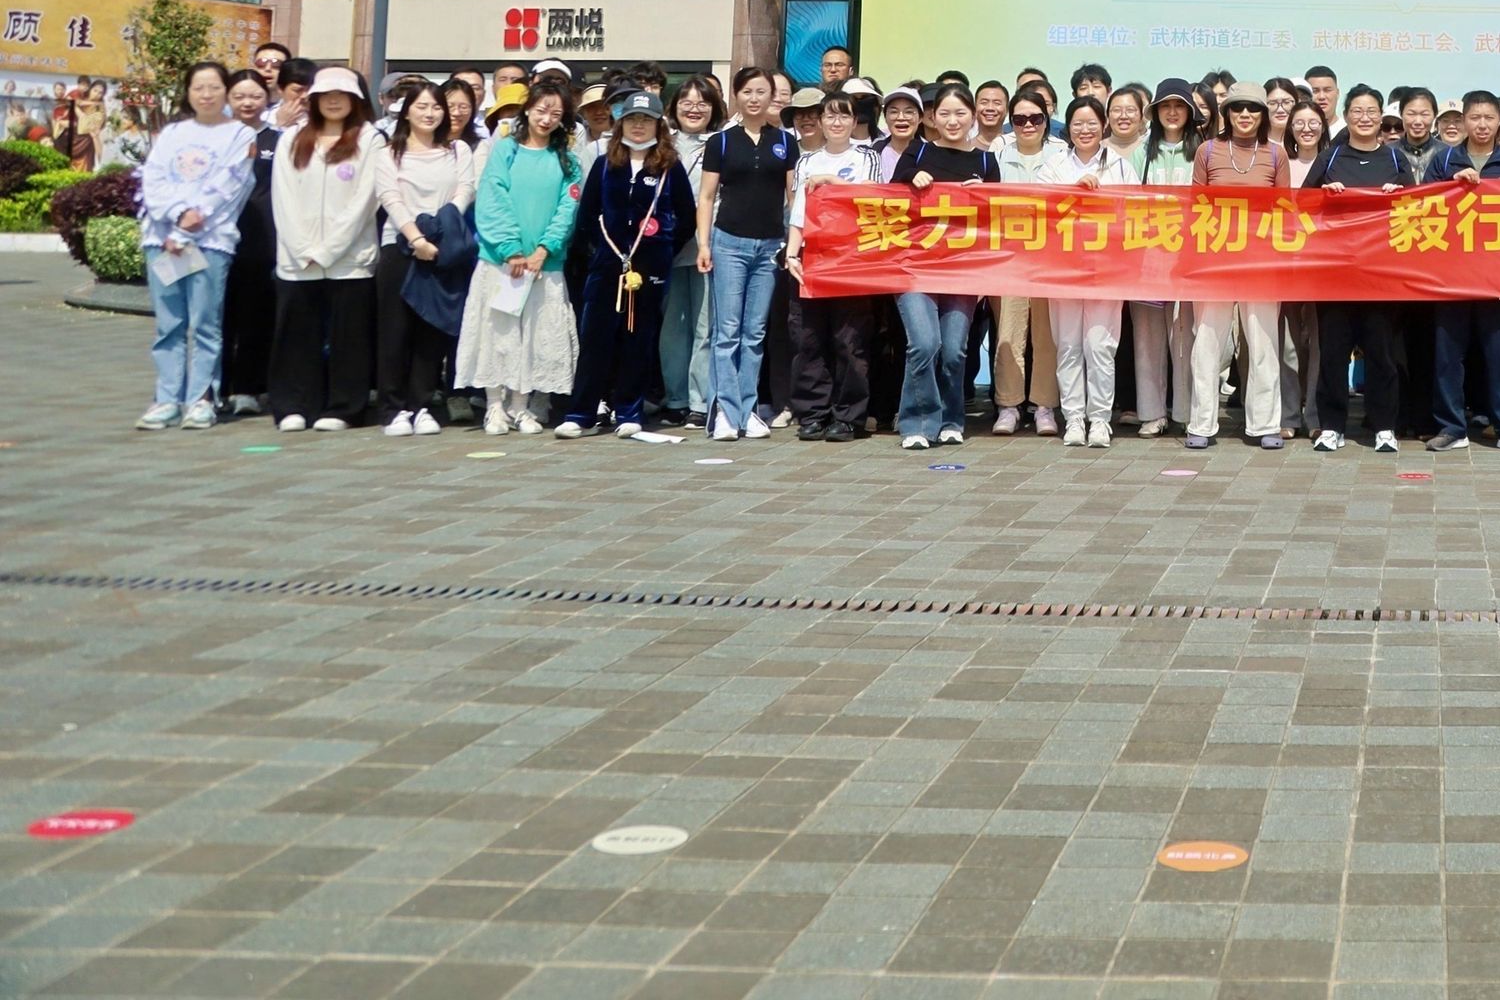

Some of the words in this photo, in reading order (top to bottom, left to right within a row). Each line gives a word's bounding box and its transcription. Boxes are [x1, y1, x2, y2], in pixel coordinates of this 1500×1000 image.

[548, 8, 604, 35] 两悦
[546, 37, 604, 49] LIANGYUE
[853, 193, 1319, 254] 聚力同行践初心
